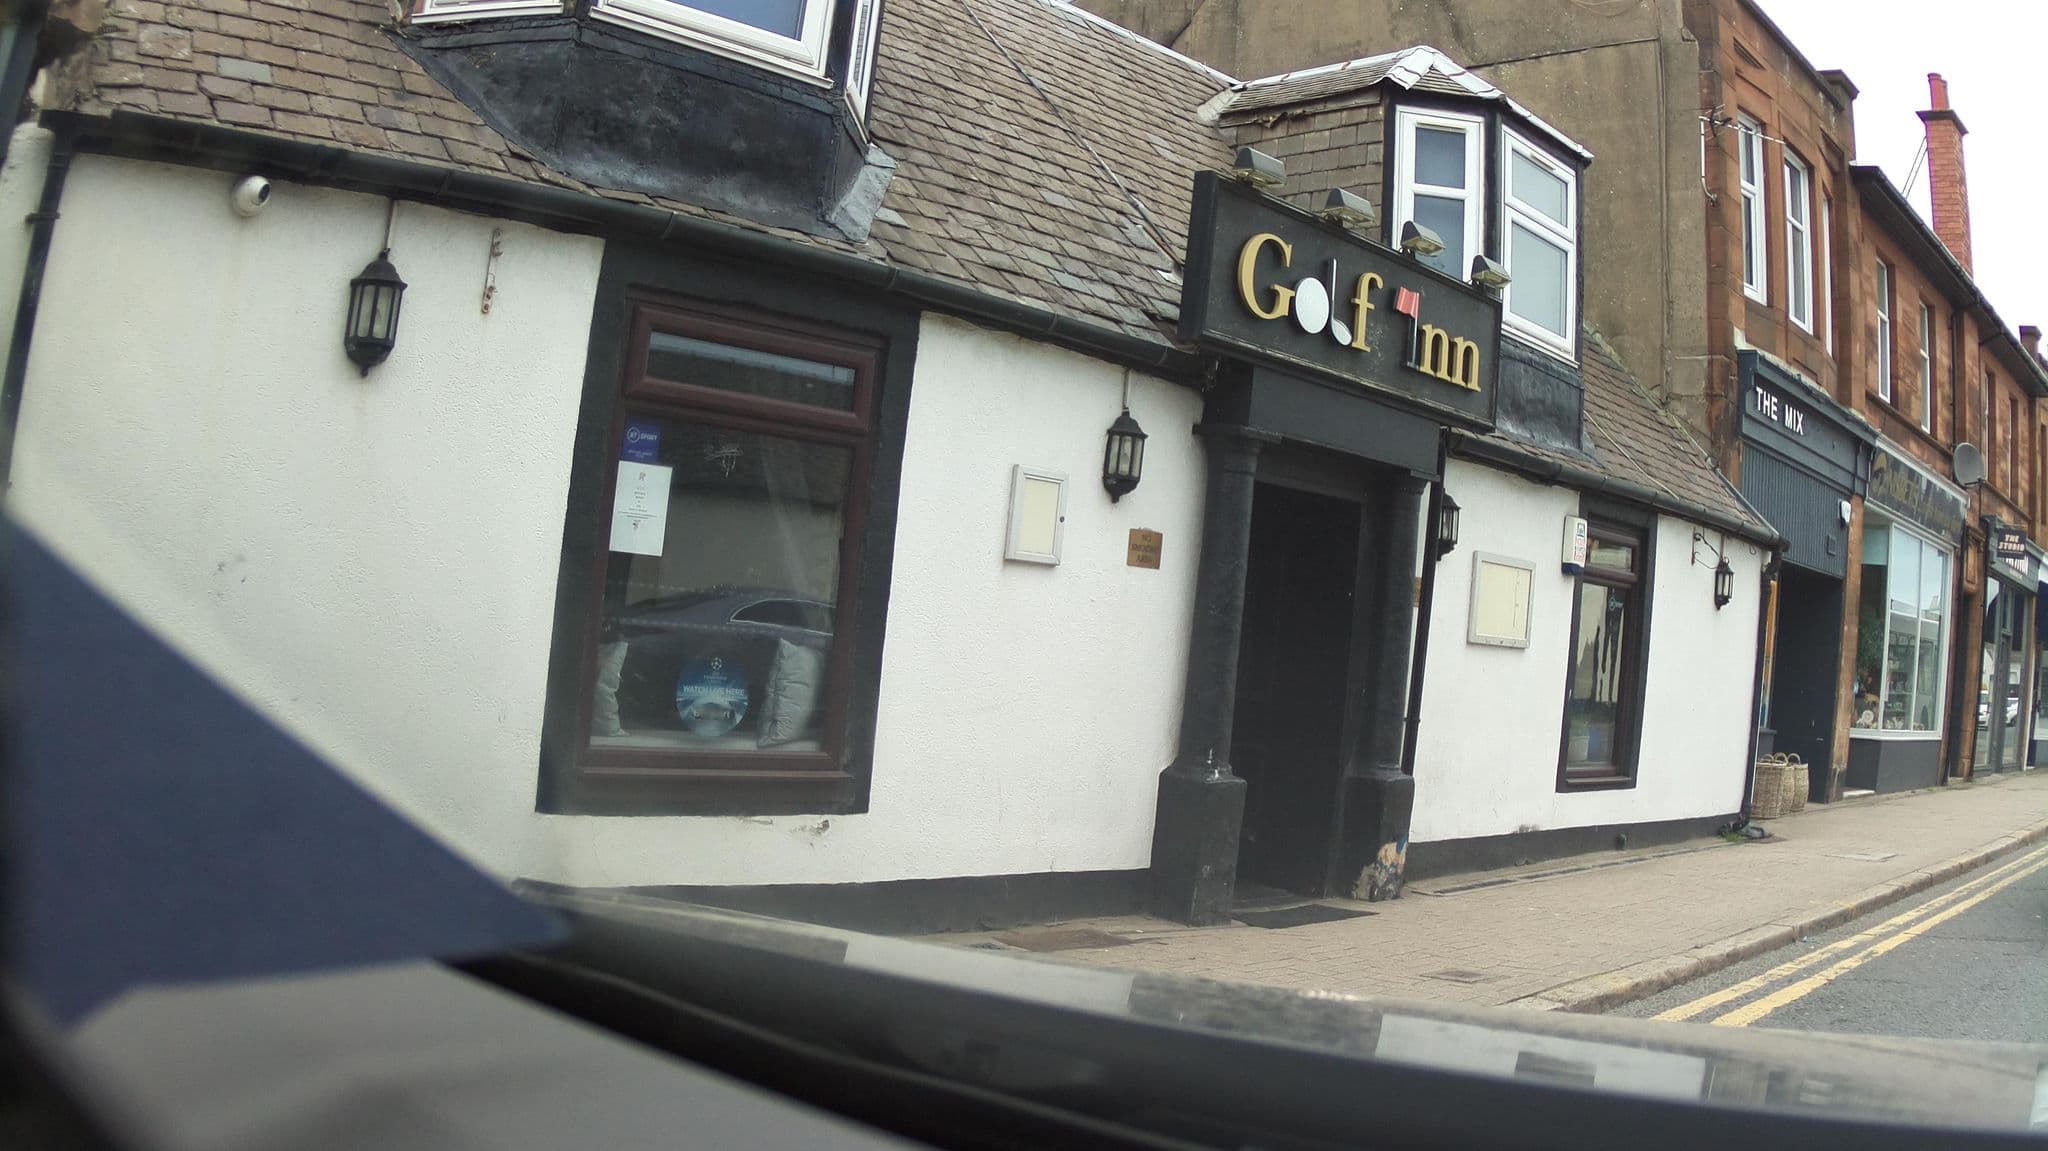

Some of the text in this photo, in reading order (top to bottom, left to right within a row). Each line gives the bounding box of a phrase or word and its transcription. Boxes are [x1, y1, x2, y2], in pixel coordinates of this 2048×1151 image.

[1237, 232, 1384, 353] Golf
[1755, 386, 1804, 436] THE MIX
[1998, 541, 2025, 552] STUDIO
[2005, 534, 2019, 543] THE
